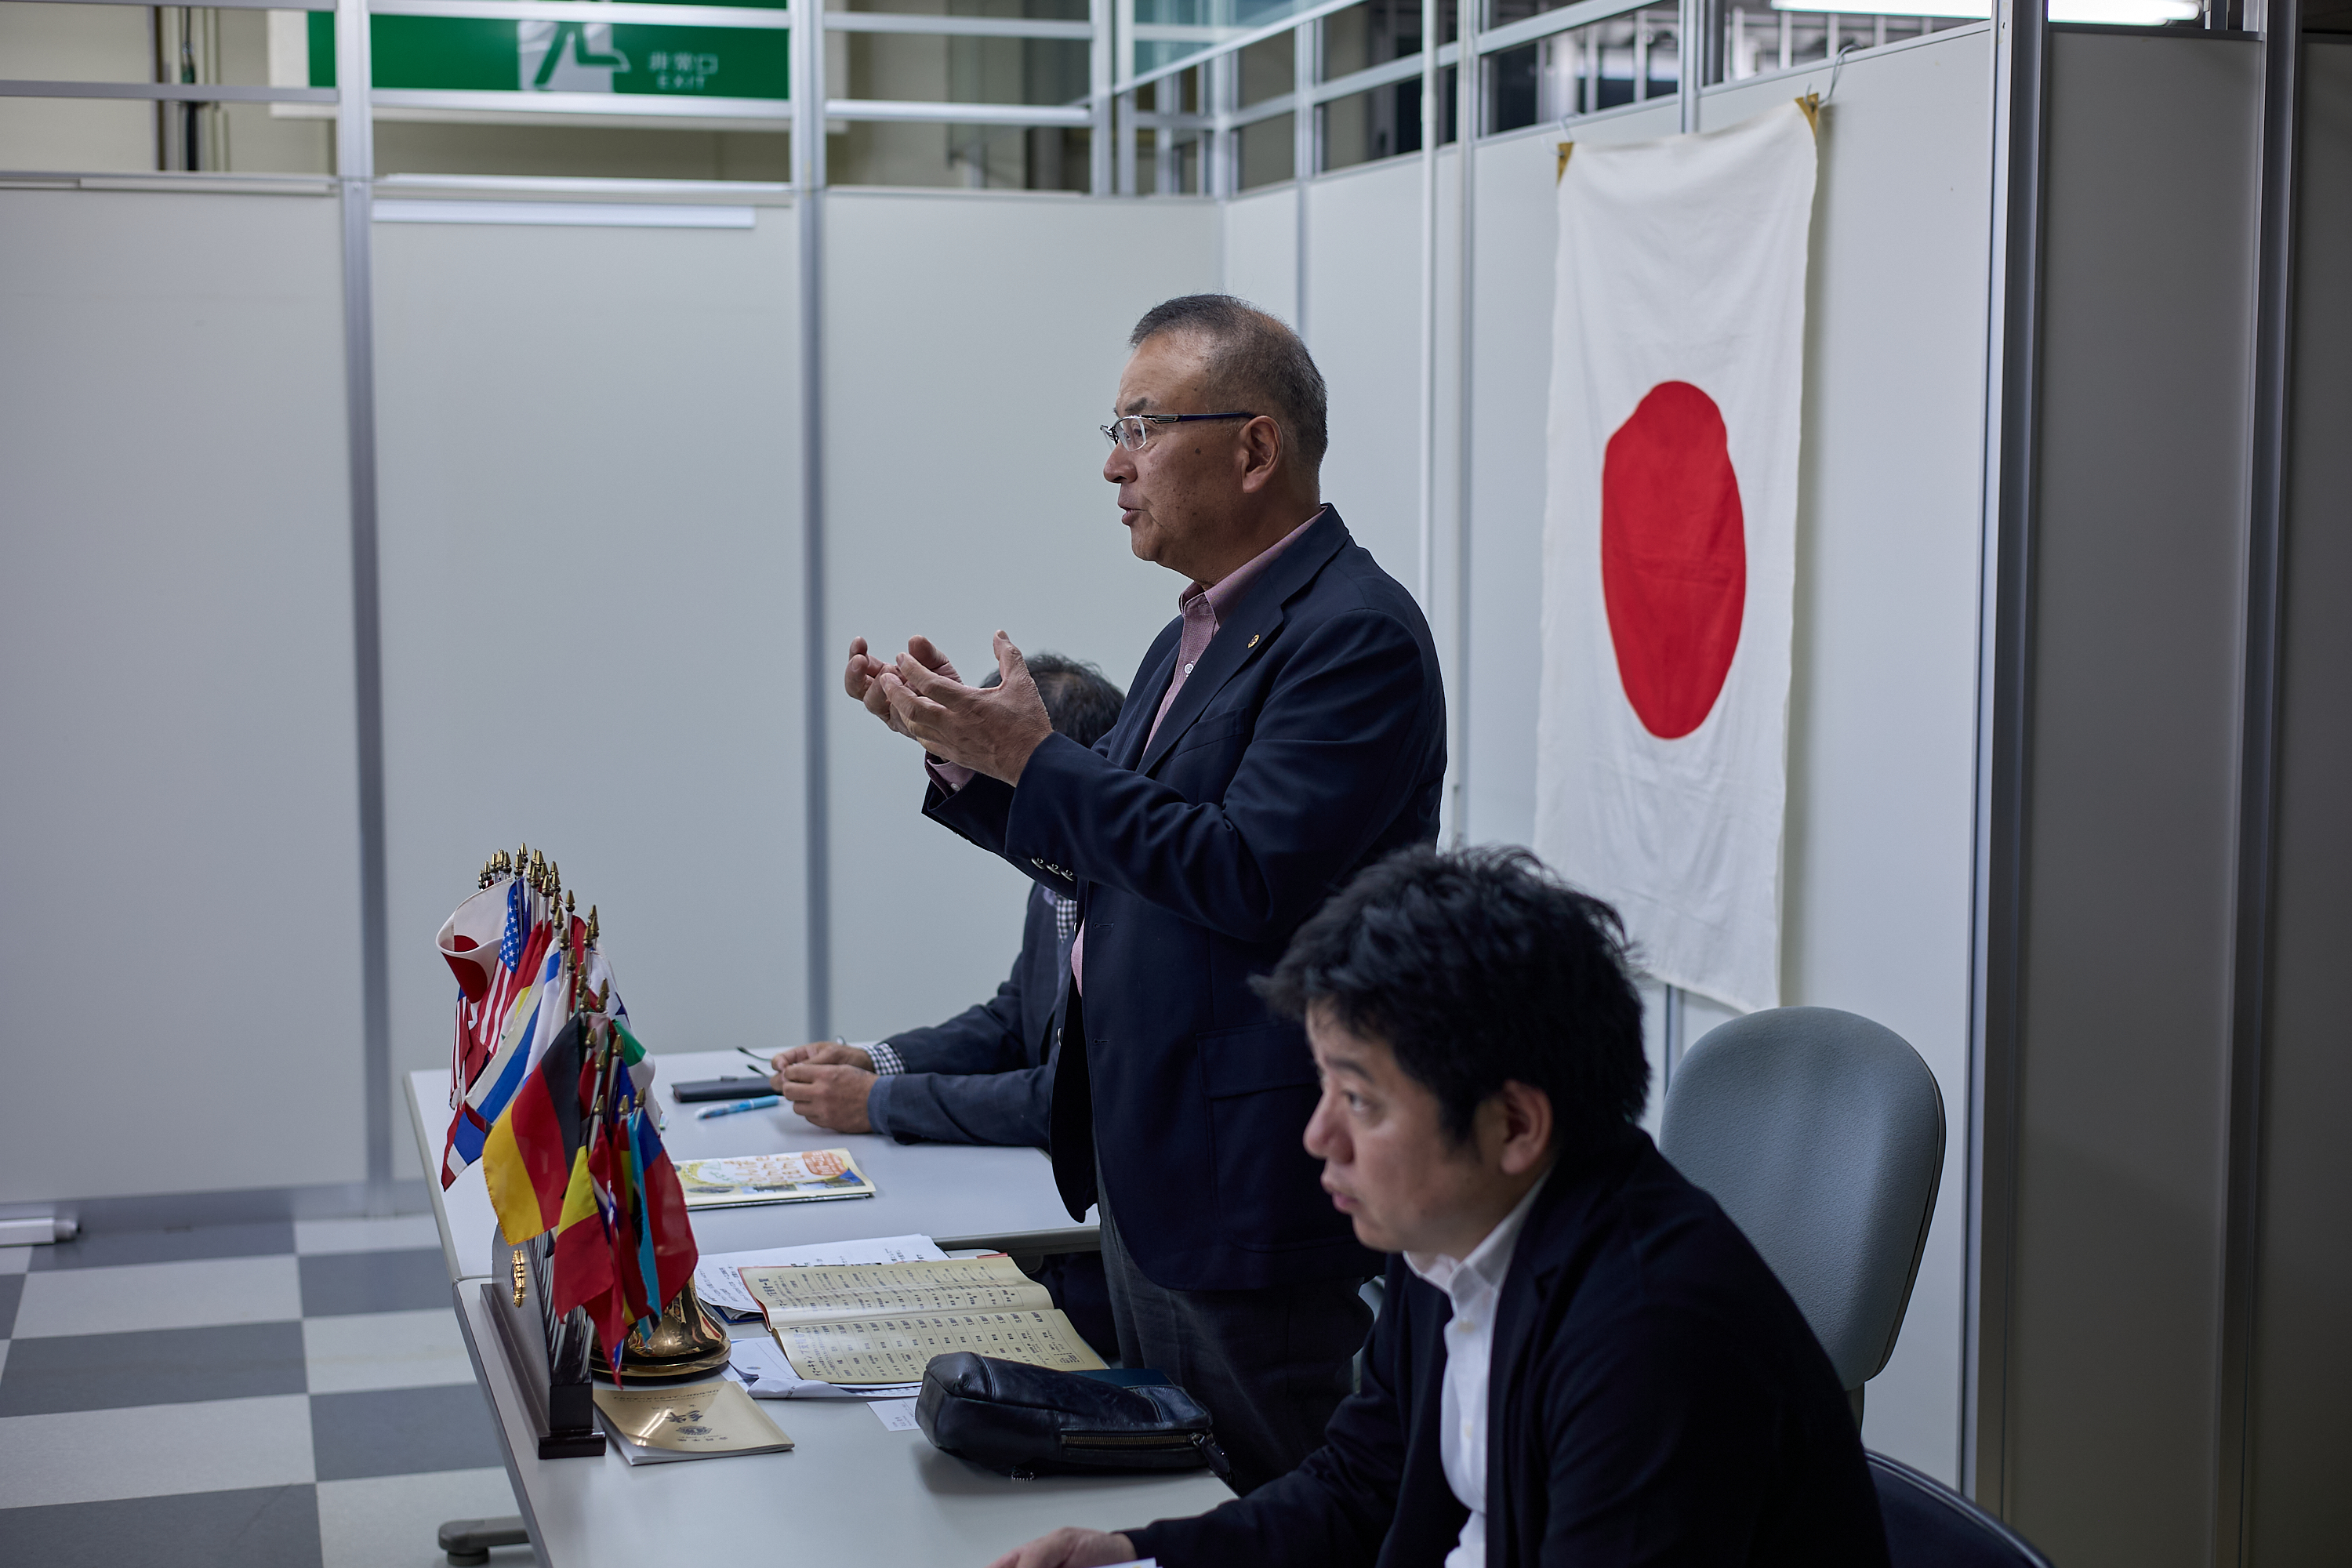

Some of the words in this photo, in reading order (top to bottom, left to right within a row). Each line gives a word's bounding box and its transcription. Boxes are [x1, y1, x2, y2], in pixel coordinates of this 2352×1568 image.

[648, 52, 718, 75] 非常口
[657, 76, 706, 90] EXIT
